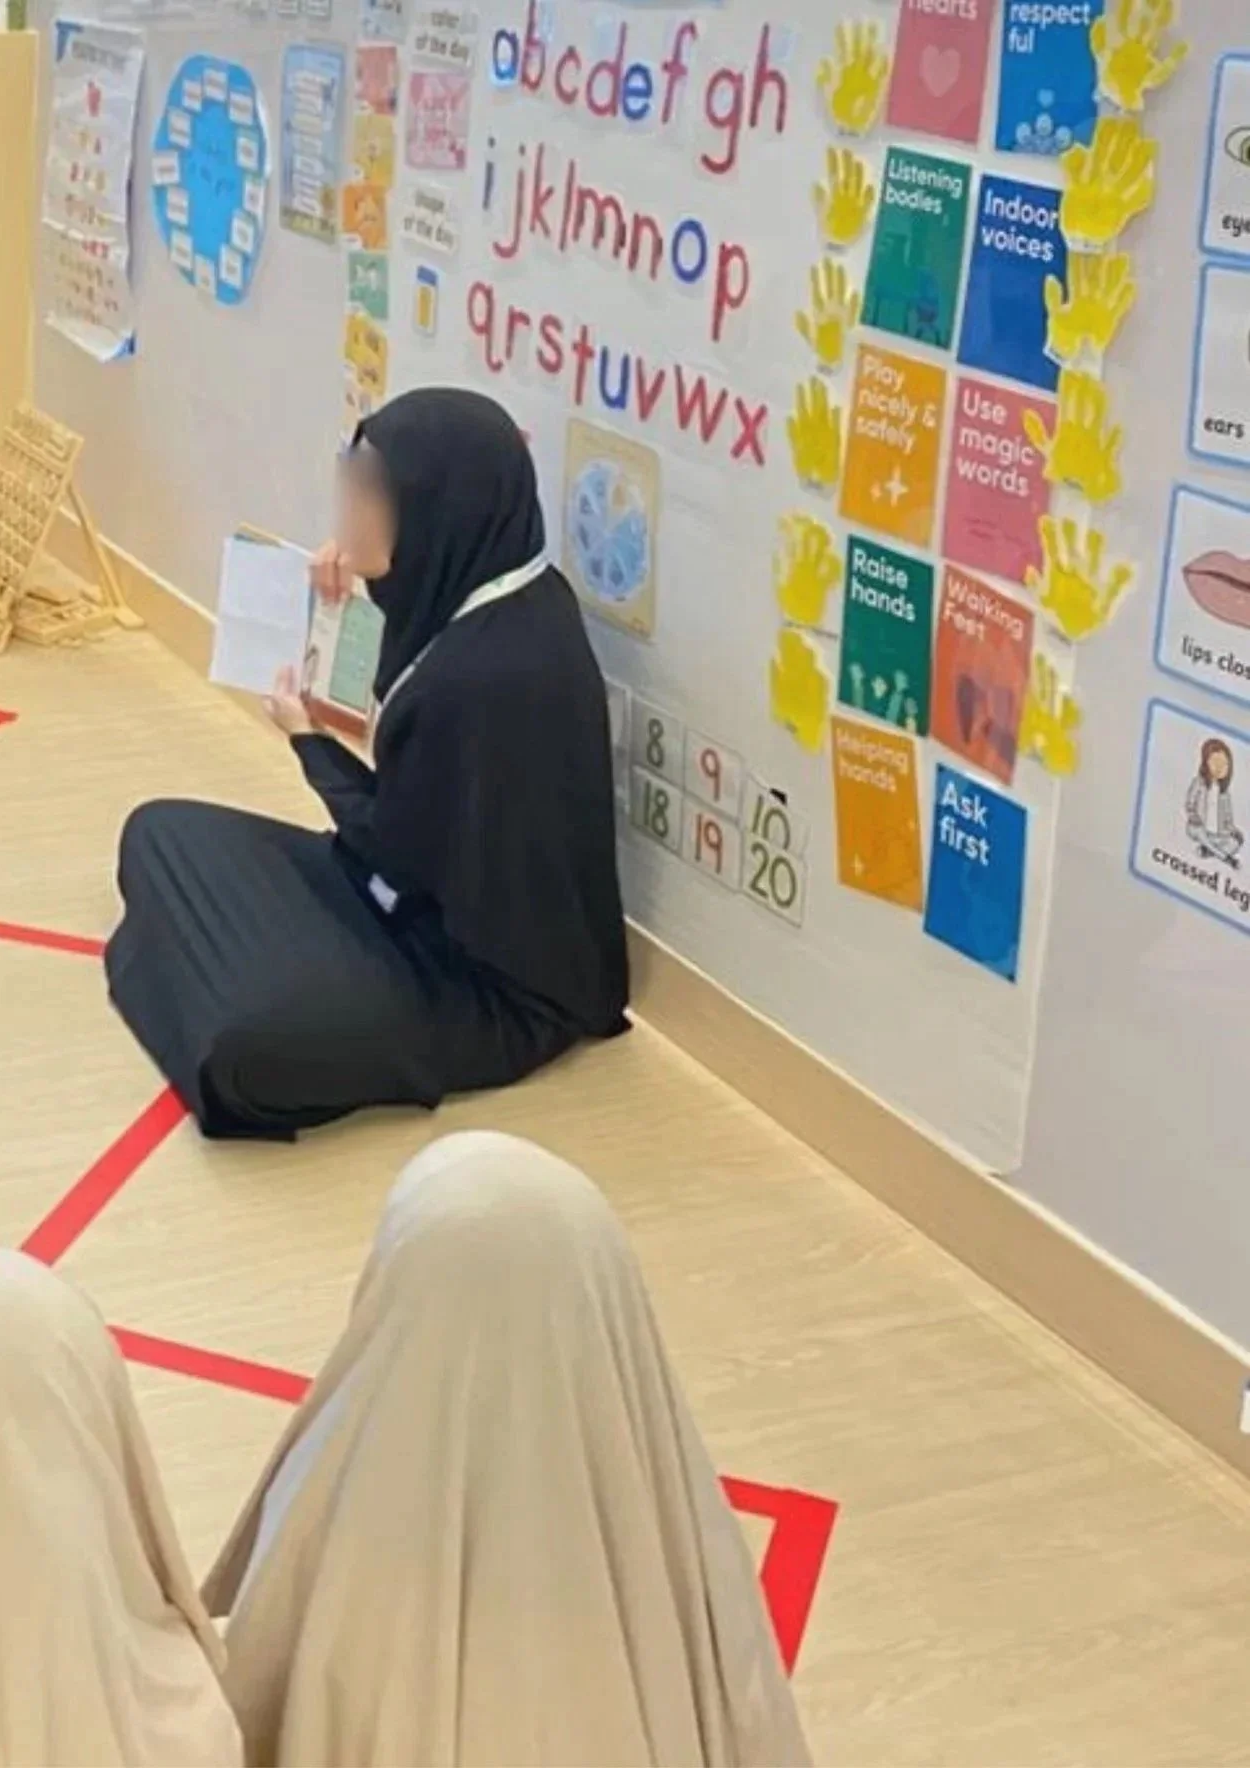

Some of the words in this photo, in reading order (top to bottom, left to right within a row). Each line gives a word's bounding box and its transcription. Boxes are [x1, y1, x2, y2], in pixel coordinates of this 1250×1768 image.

[1008, 2, 1091, 29] respect
[1008, 26, 1035, 53] ful
[885, 181, 943, 215] bodies
[888, 157, 964, 199] Listening
[983, 188, 1059, 230] Indoor
[981, 226, 1054, 263] voices
[862, 353, 906, 393] Play
[858, 386, 918, 427] nicely
[922, 402, 937, 429] &
[962, 387, 1008, 426] Use
[855, 415, 917, 456] safely
[958, 426, 1036, 467] magic
[1203, 417, 1245, 439] ears
[955, 456, 1031, 498] words
[852, 547, 909, 591] Raise
[851, 575, 917, 623] hands
[946, 574, 1025, 642] Walking
[1181, 634, 1213, 667] lips
[646, 718, 665, 768] 8
[700, 747, 721, 802] 9
[835, 727, 909, 775] Helping
[838, 754, 898, 793] hands
[940, 779, 989, 830] Ask
[642, 780, 670, 839] 18
[695, 812, 724, 875] 19
[750, 842, 797, 909] 20
[938, 814, 991, 867] first
[1151, 846, 1219, 894] crossed
